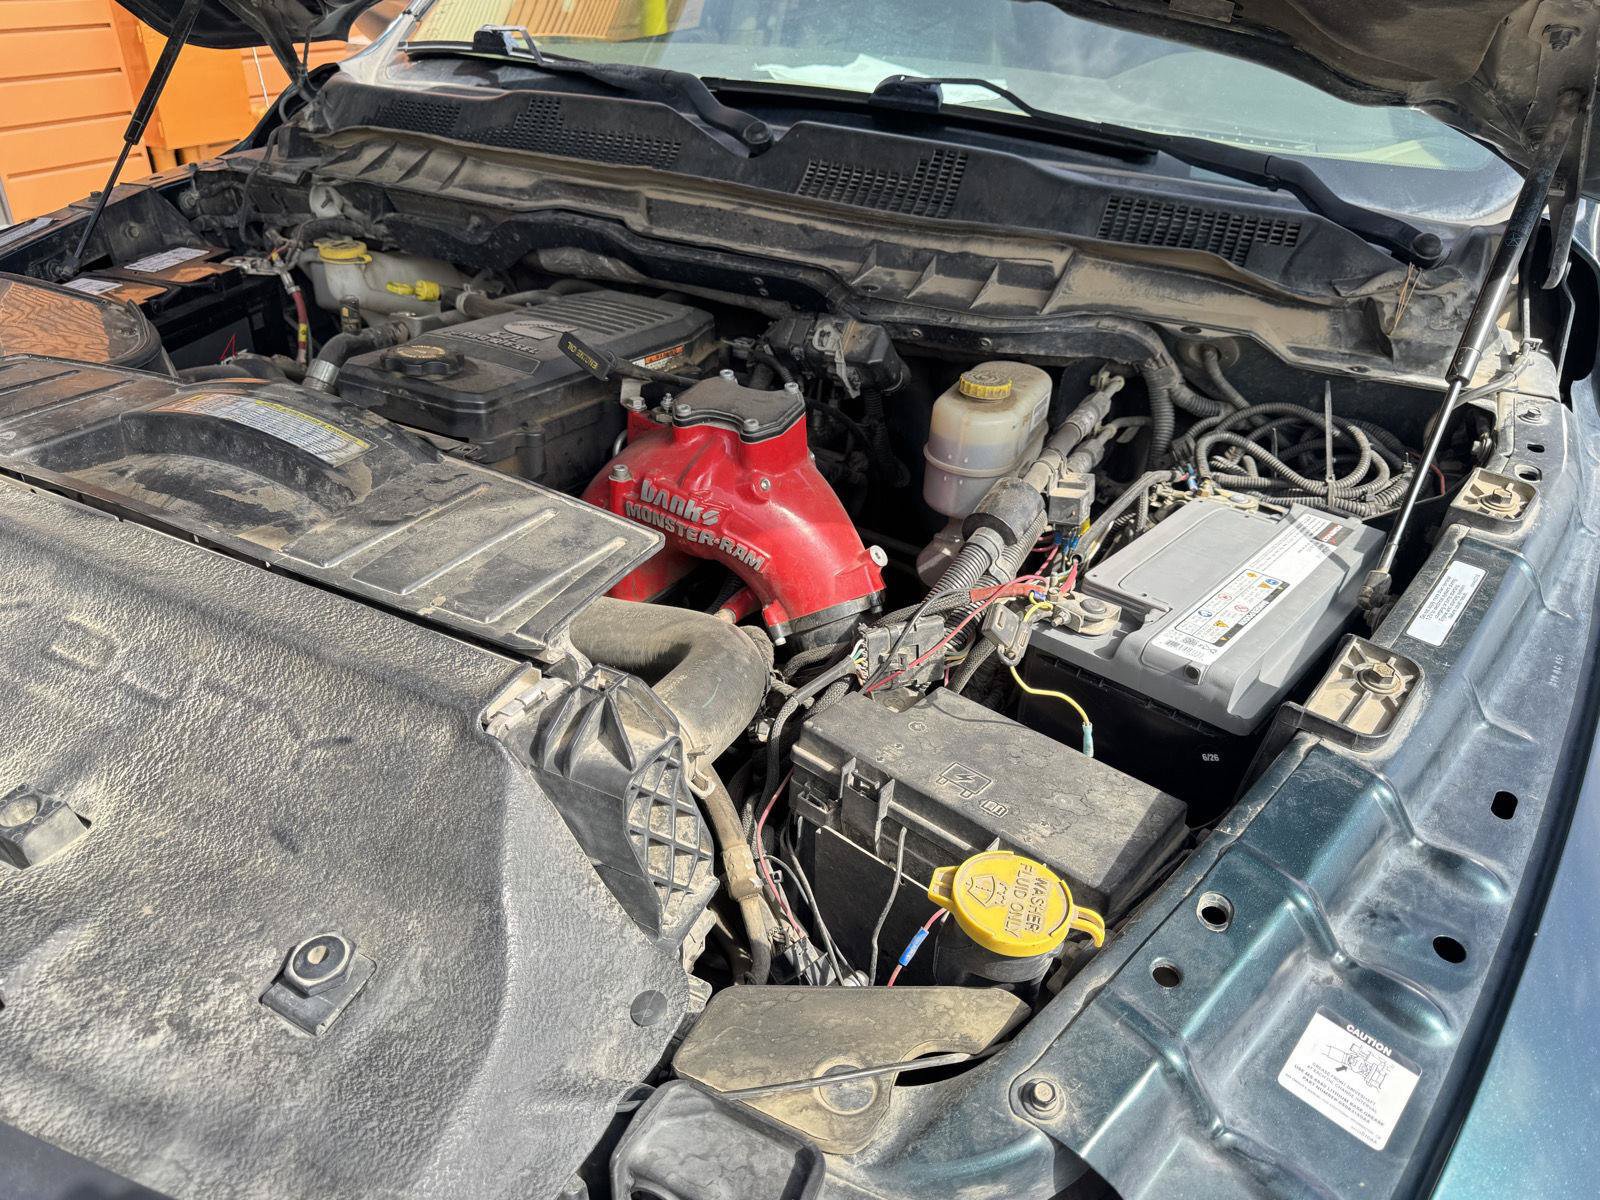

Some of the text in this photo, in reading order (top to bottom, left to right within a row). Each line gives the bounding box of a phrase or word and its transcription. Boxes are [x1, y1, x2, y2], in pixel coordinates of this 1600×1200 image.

[1004, 862, 1033, 938] FLUID ONLY
[1025, 877, 1048, 934] WASHER
[1346, 1024, 1393, 1057] CAUTION
